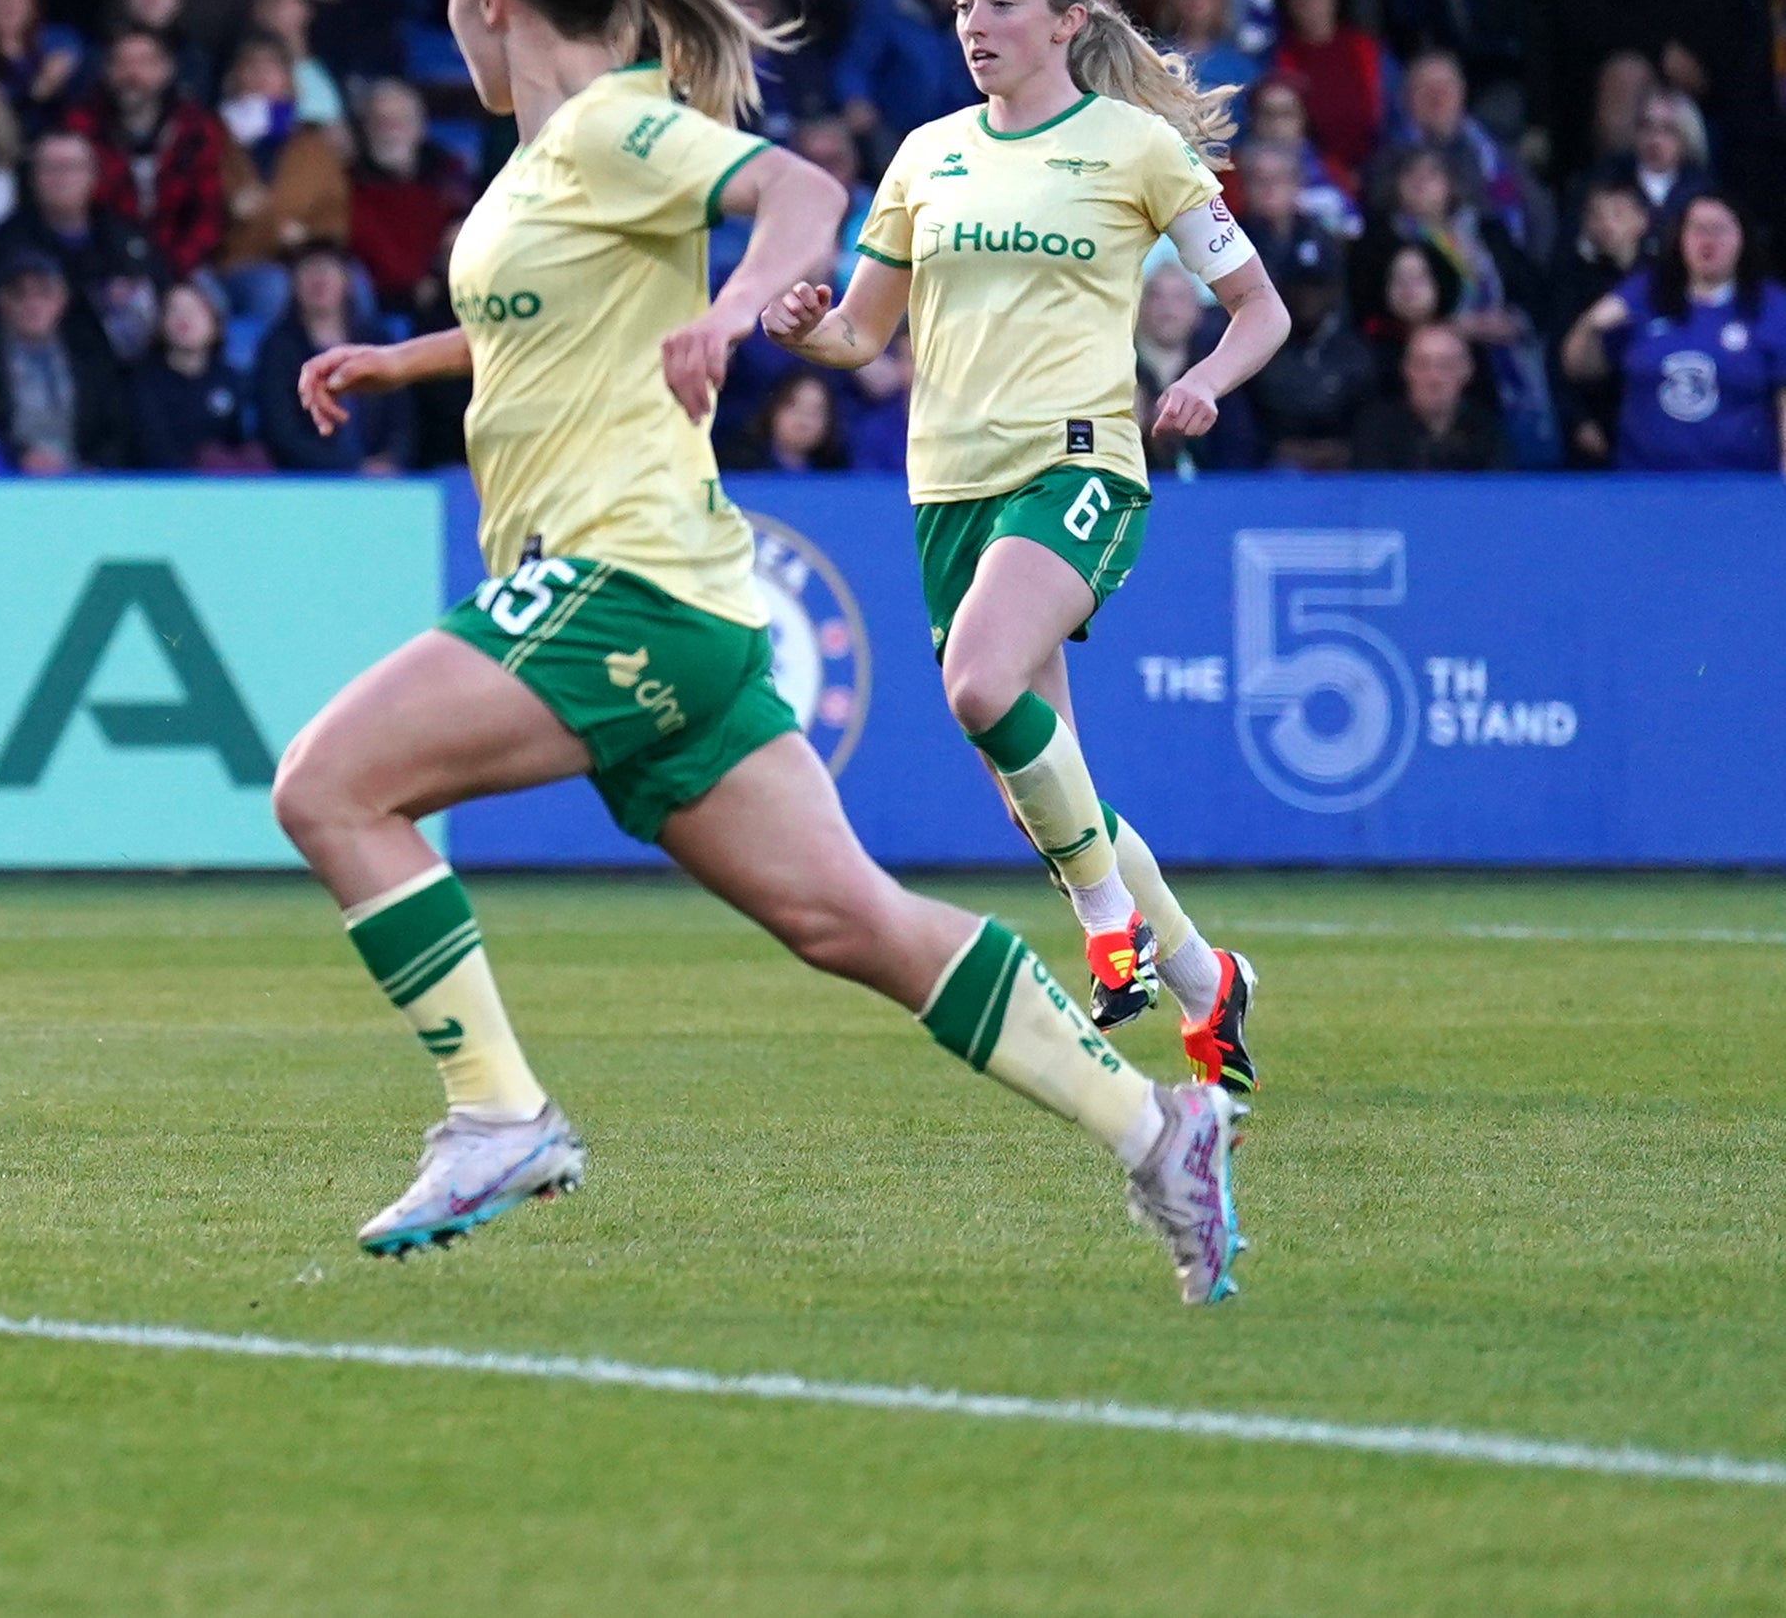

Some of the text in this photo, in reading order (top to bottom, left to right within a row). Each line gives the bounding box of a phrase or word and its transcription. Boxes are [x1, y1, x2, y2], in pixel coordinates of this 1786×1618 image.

[953, 222, 1097, 261] Huboo
[1063, 476, 1111, 542] 6
[1137, 527, 1420, 814] THE 5
[1427, 657, 1487, 696] TH
[1428, 701, 1579, 748] STAND
